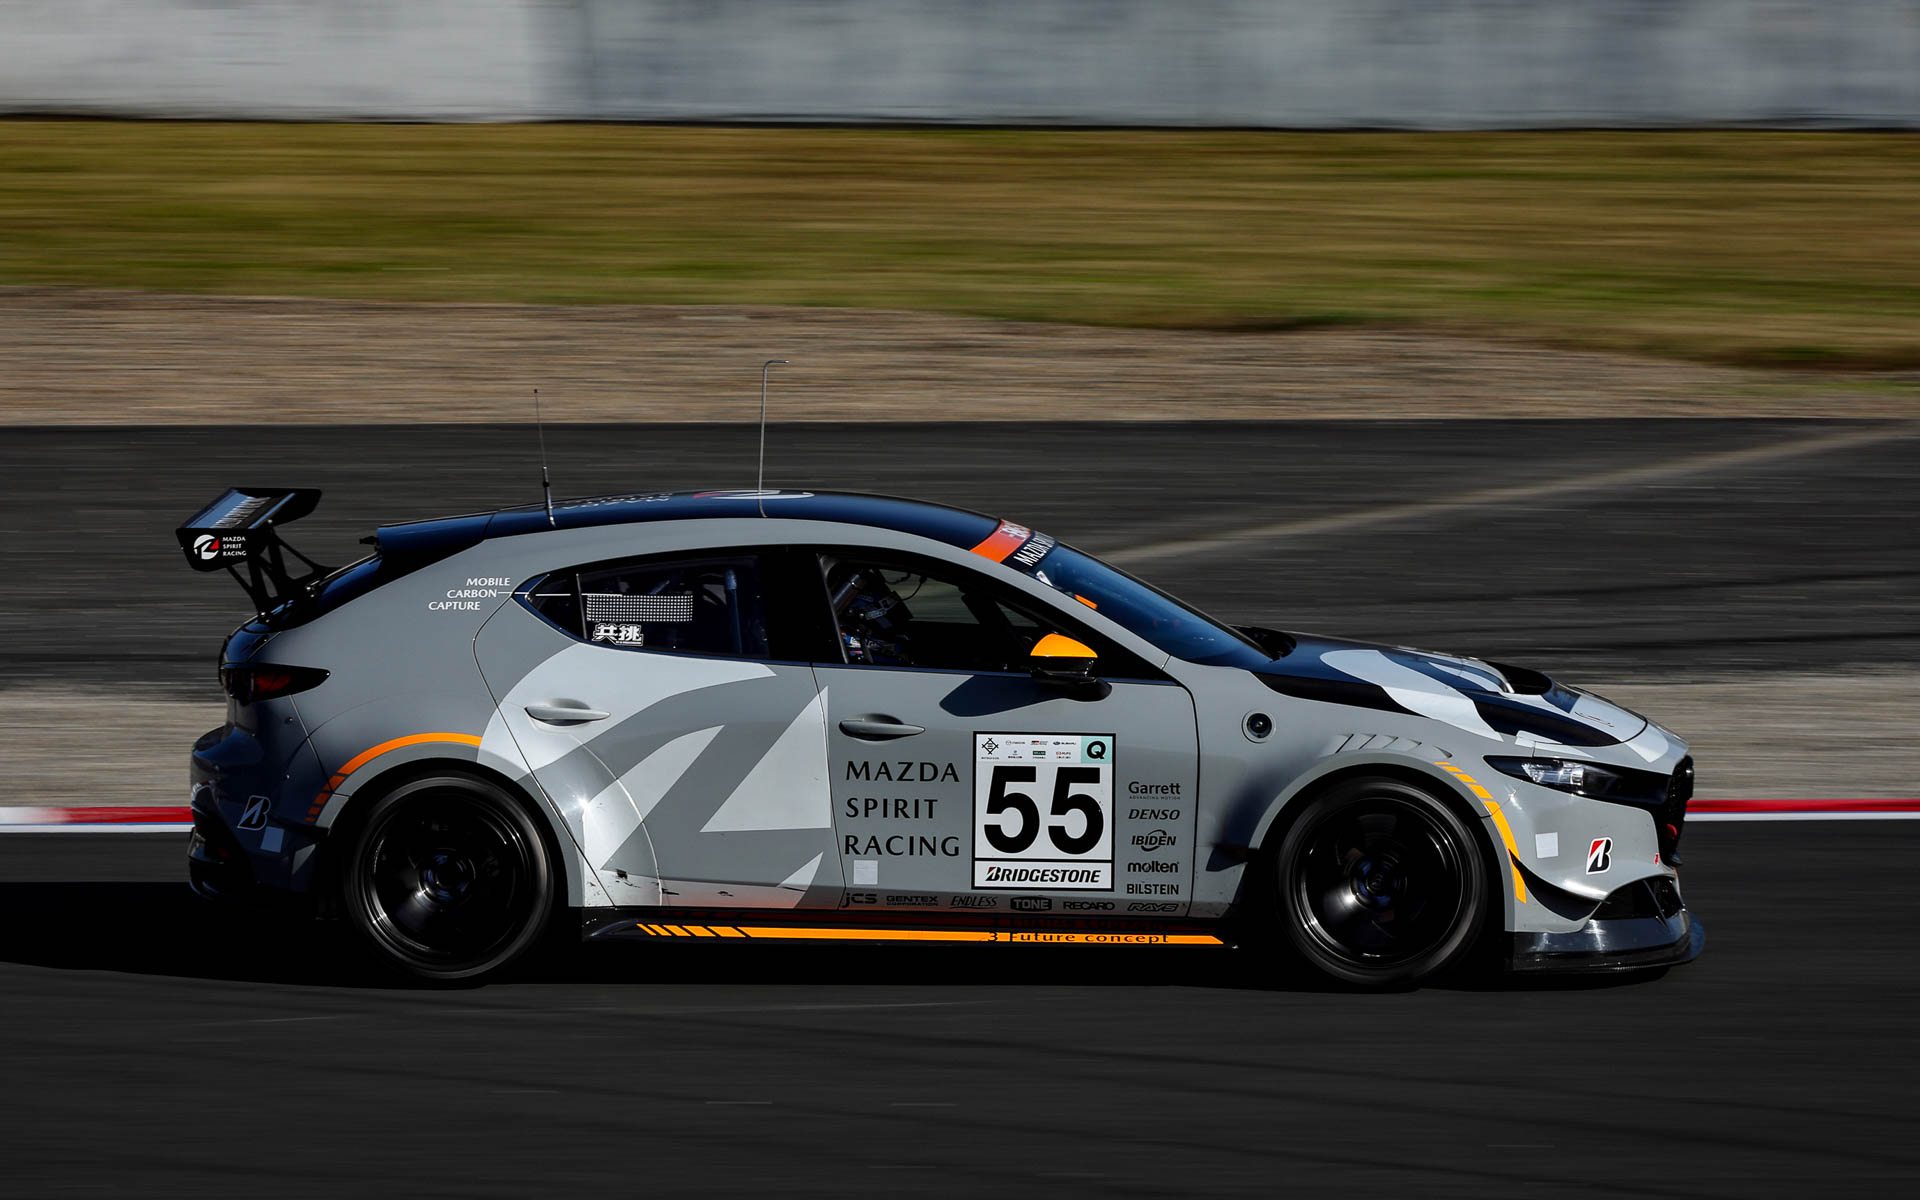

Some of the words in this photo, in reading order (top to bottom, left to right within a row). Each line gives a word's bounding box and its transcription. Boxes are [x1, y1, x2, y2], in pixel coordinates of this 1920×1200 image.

[466, 577, 511, 587] MOBILE
[446, 589, 497, 599] CARBON
[428, 601, 481, 611] CAPTURE
[1086, 740, 1107, 760] Q
[846, 761, 960, 783] MAZDA
[1128, 781, 1181, 795] Garrett
[845, 797, 938, 819] SPIRIT
[983, 765, 1104, 855] 55
[1128, 809, 1181, 821] DENSO
[845, 835, 960, 857] RACING
[1131, 834, 1177, 849] IBIDEN
[1127, 861, 1179, 873] molten
[985, 866, 1102, 883] BRIDGESTONE
[1127, 883, 1179, 895] BILSTEIN
[951, 896, 998, 908] ENDLESS
[1012, 898, 1050, 910] TONE
[1063, 901, 1115, 911] RECARO
[1128, 902, 1179, 912] RAYS
[1010, 931, 1076, 944] Future
[1084, 932, 1168, 945] concept
